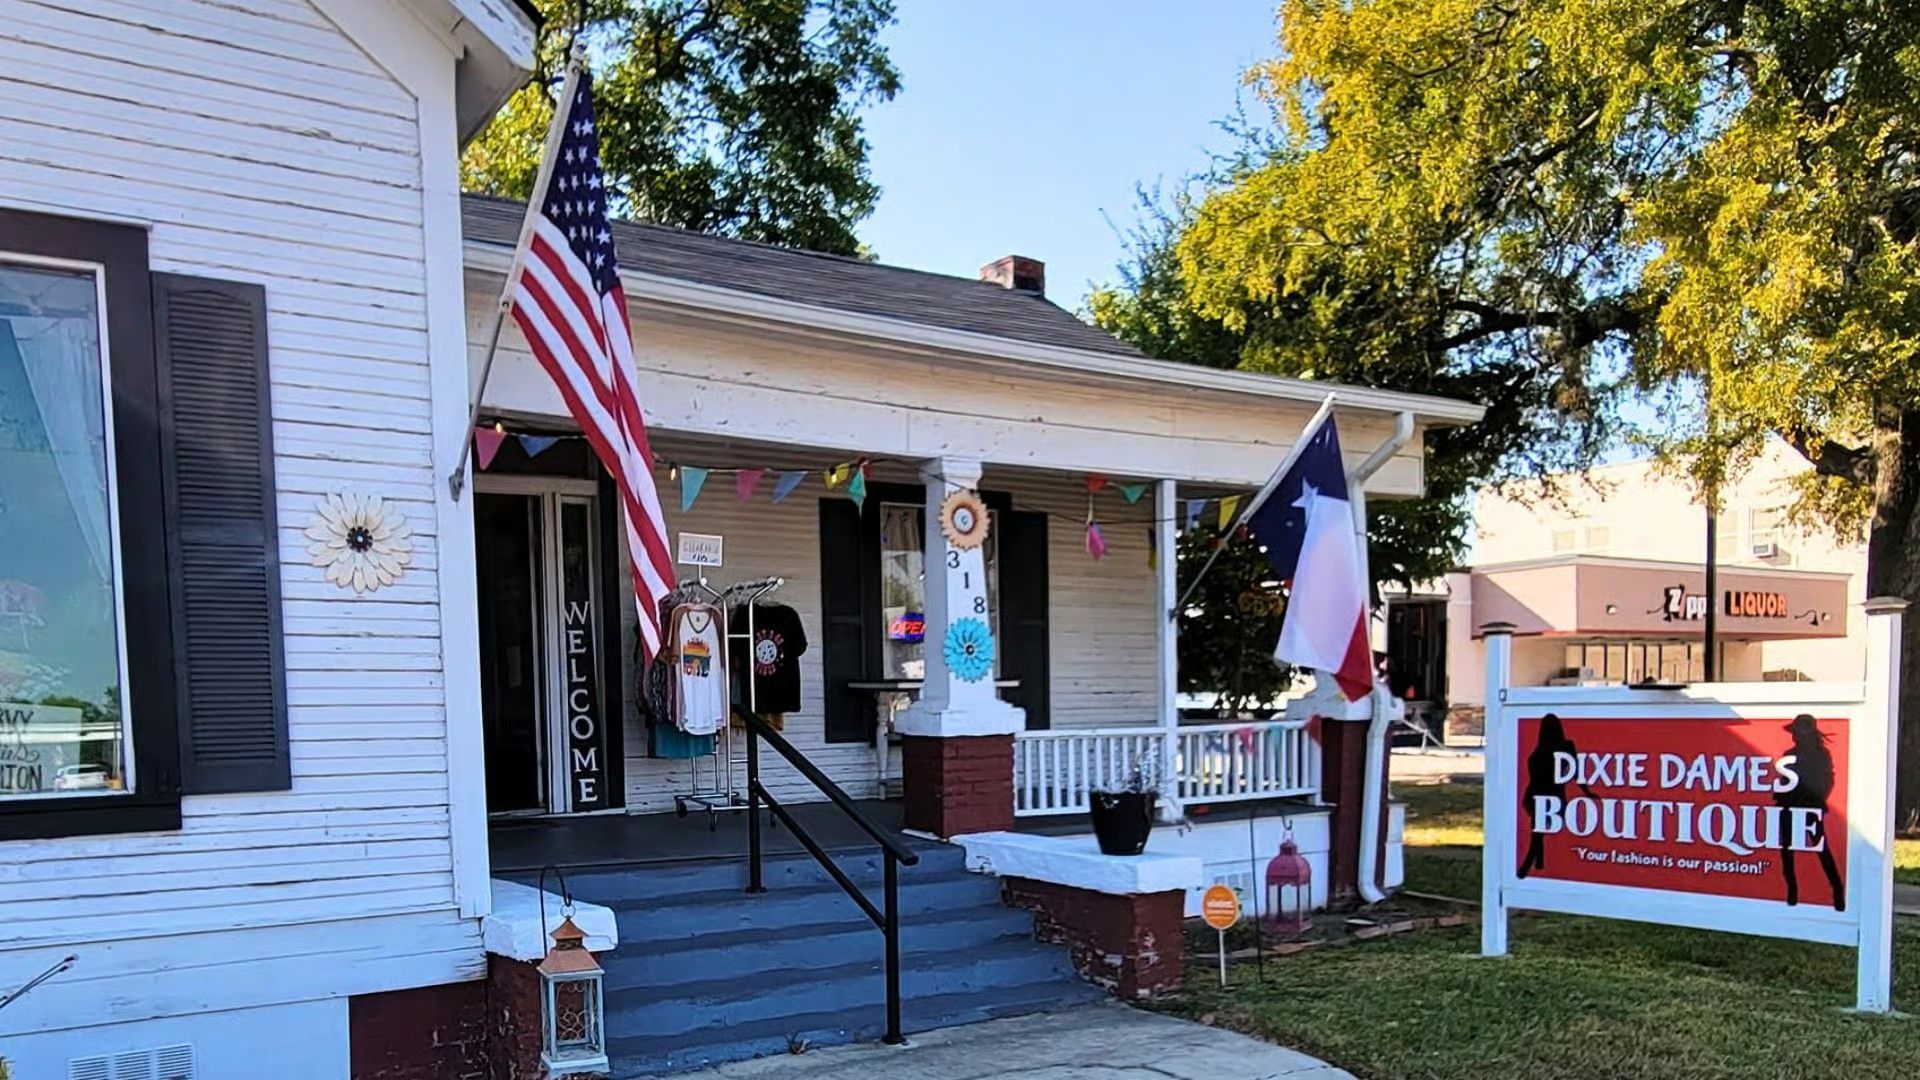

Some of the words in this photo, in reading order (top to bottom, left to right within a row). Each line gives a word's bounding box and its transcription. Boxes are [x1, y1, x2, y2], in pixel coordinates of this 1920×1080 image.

[1666, 584, 1708, 621] Zipp
[1728, 591, 1788, 617] LIQUOR
[564, 601, 598, 803] WELCOME
[1552, 751, 1648, 788] DIXIE
[1659, 753, 1799, 793] DAMES
[1532, 795, 1825, 856] BOUTIQUE
[1611, 850, 1659, 865] fashion
[1662, 853, 1674, 867] is
[1677, 857, 1700, 869] our
